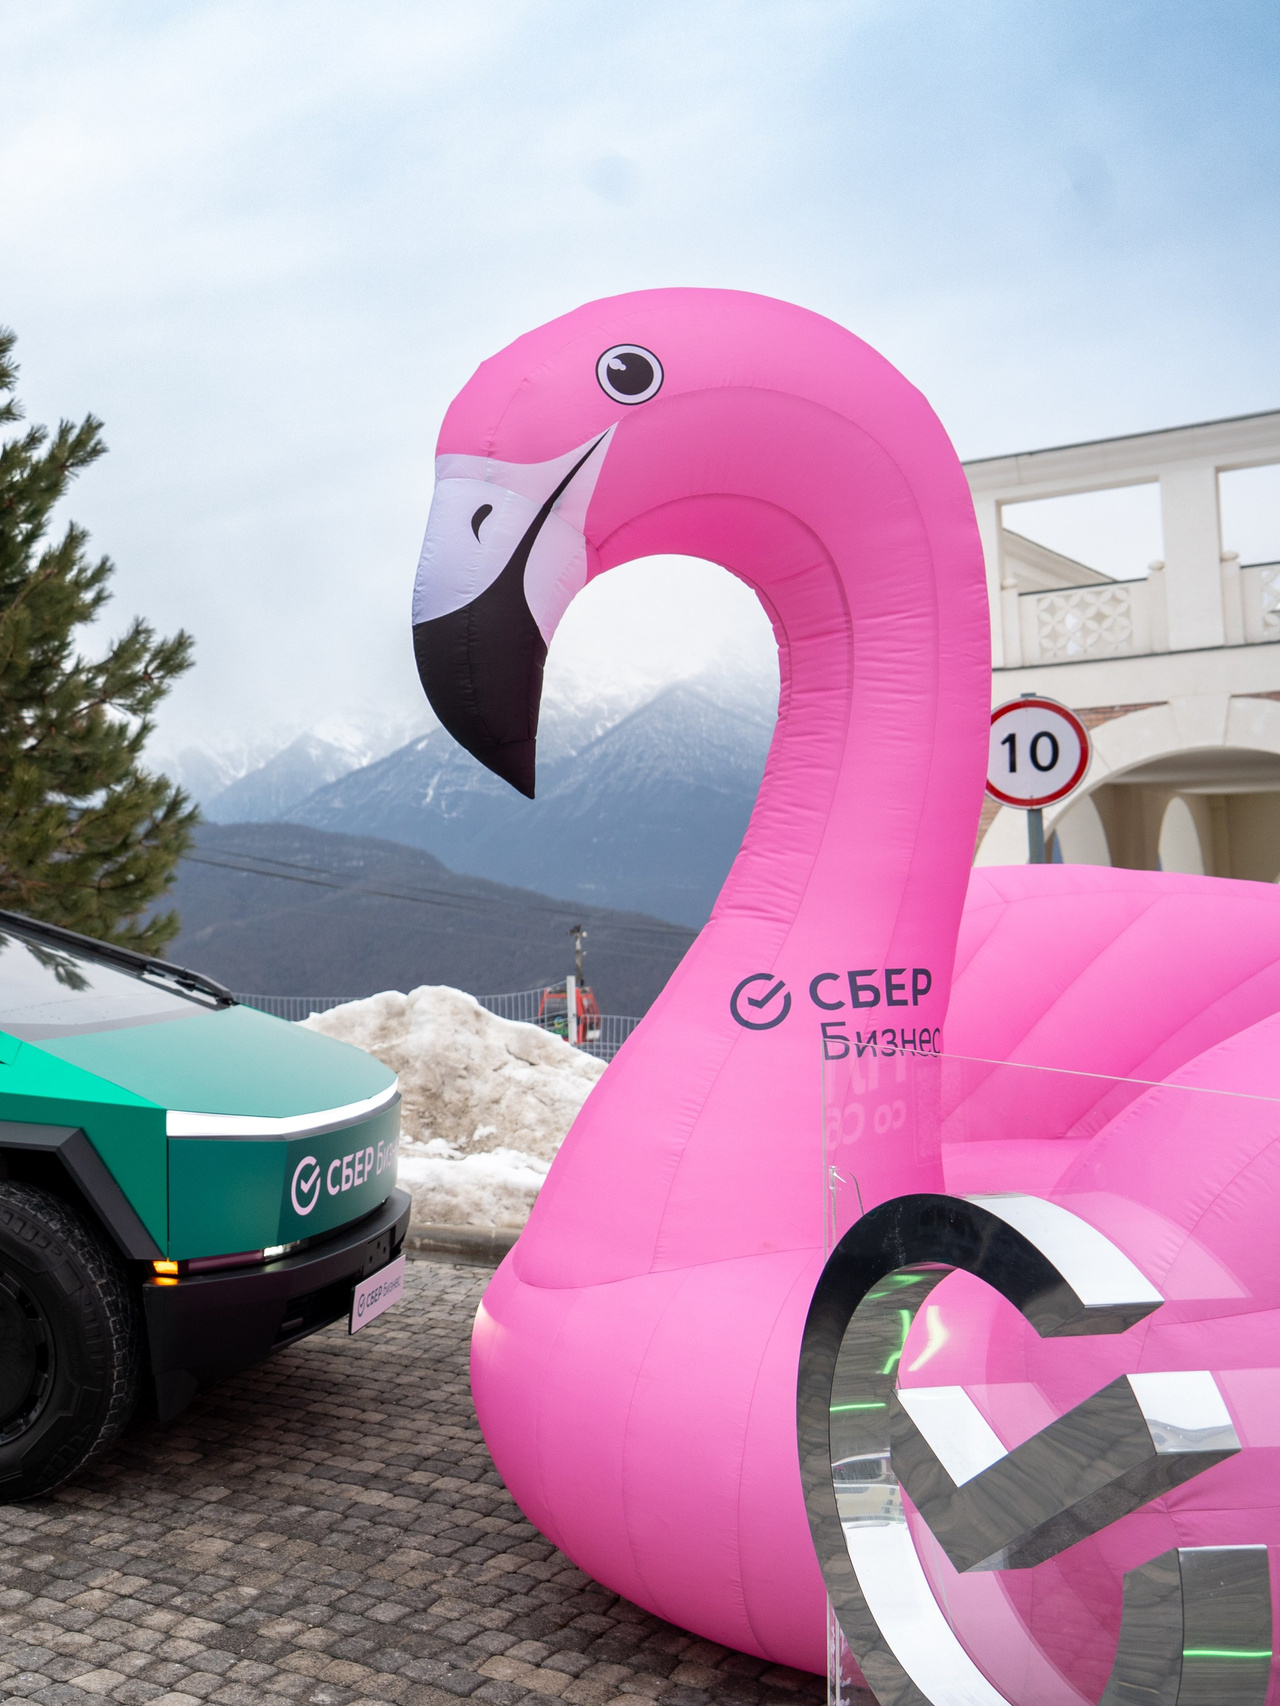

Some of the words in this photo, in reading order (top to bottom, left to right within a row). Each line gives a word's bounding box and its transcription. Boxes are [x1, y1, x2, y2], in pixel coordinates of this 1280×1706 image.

[1001, 731, 1059, 773] 10
[809, 968, 932, 1011] СБЕР
[820, 1021, 940, 1061] Бизнес
[326, 1146, 374, 1196] СБЕР
[366, 1285, 383, 1308] СБЕР
